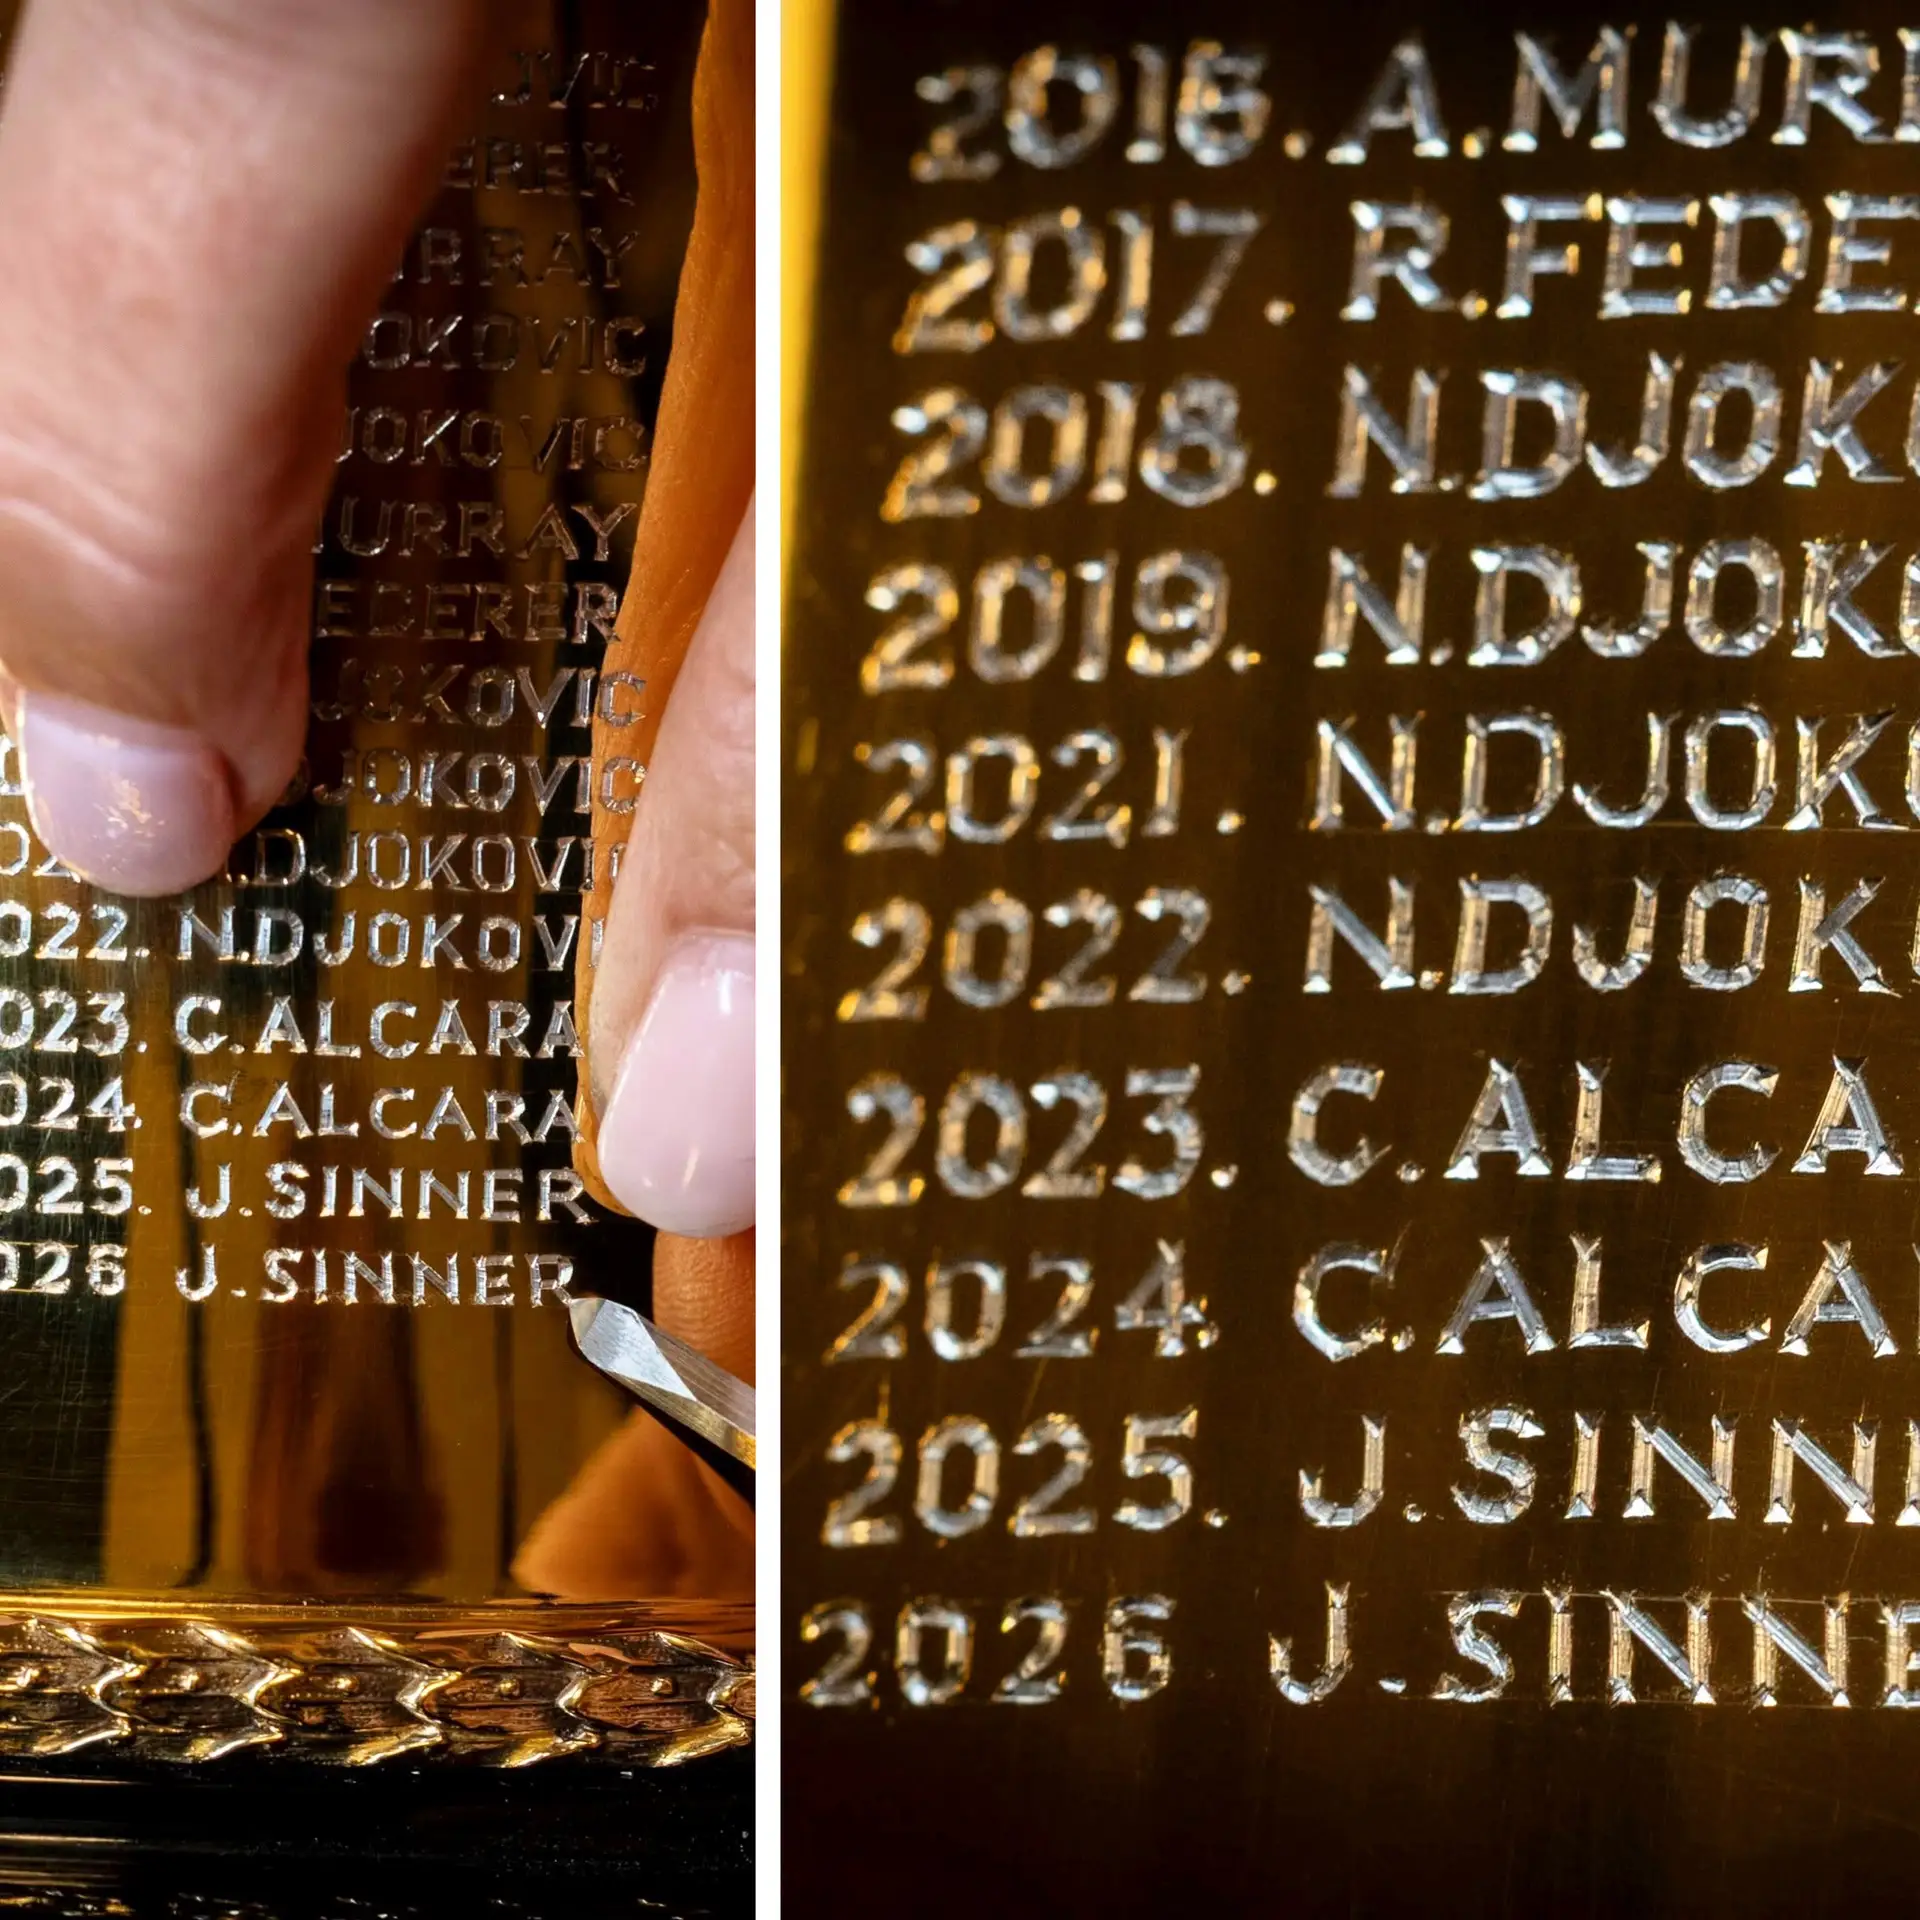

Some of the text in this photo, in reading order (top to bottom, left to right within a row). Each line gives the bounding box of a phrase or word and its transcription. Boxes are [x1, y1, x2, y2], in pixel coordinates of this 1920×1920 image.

[1325, 22, 1920, 166] A.MUR
[392, 228, 640, 290] RRAY
[893, 190, 1920, 358] 2017. R.FEDE
[879, 350, 1920, 524] 2018. N.DJOK
[310, 496, 637, 561] URRAY
[860, 536, 1920, 696] 2019. N.DJOK
[295, 748, 648, 817] JOKOVIC
[845, 702, 1920, 856] 2021. N.DJOK
[225, 826, 628, 894] .DJOKOVI
[836, 868, 1920, 1024] 2022. N.DJOK
[174, 994, 586, 1059] C.ALCARA
[179, 1080, 586, 1144] C.ALCARA
[836, 1062, 1240, 1208] 2023.
[820, 1222, 1920, 1366] 2024. C.ALCA
[820, 1402, 1920, 1548] 2025. J.SINN
[798, 1594, 1178, 1708] 2026
